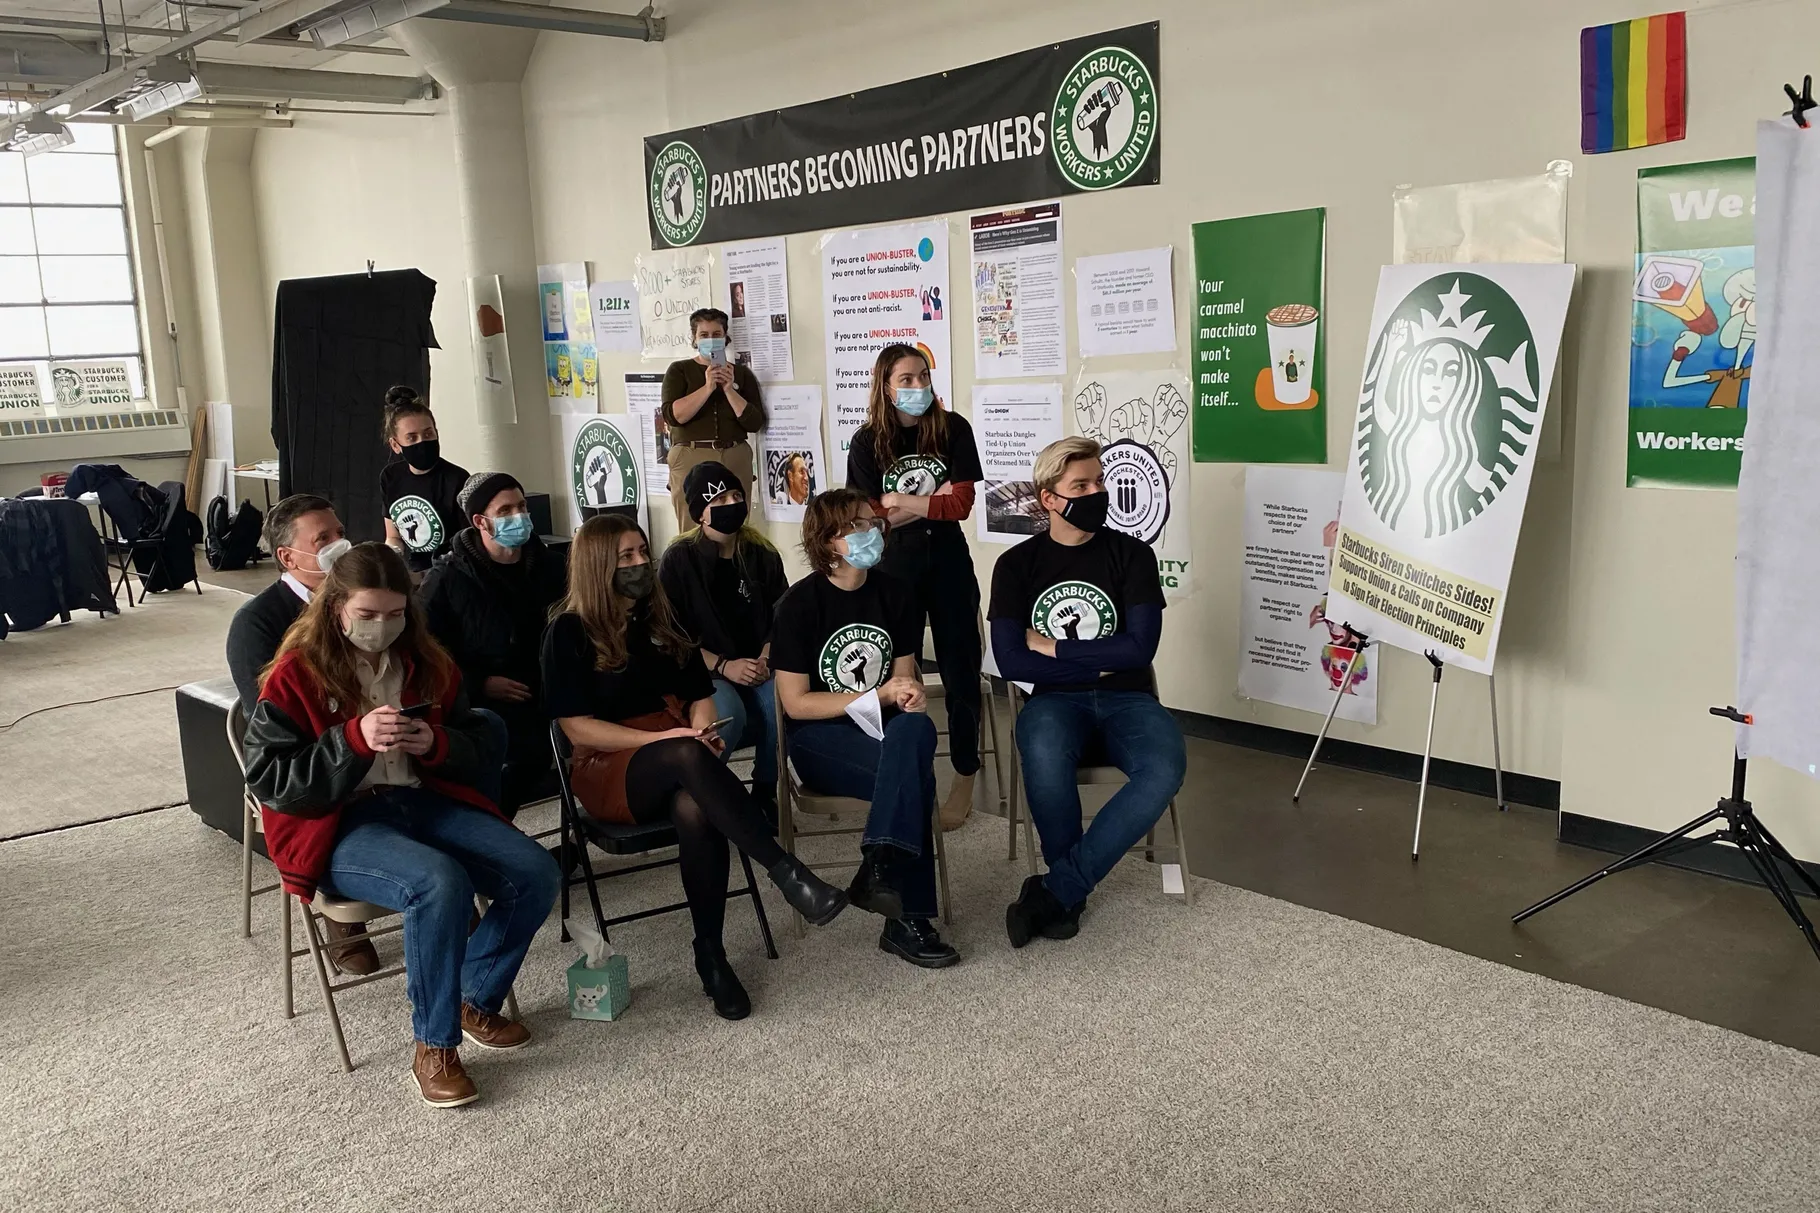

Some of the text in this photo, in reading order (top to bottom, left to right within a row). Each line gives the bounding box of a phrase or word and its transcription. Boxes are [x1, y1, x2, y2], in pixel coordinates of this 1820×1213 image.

[1066, 56, 1143, 99] STARBUCKS
[1056, 110, 1150, 181] WORKERS UNITED
[657, 148, 700, 178] STARBUCKS
[710, 111, 1046, 208] PARTNERS BECOMING PARTNERS
[1669, 188, 1743, 222] We
[653, 189, 702, 239] WORKERS UNITED
[831, 257, 835, 265] If
[836, 257, 847, 266] you
[866, 248, 916, 261] UNION-BUSTER,
[672, 265, 706, 278] STARBUCKS
[832, 271, 842, 280] you
[867, 266, 876, 274] for
[878, 262, 922, 274] sustainability.
[681, 277, 701, 288] STORES
[1200, 279, 1224, 293] Your
[833, 294, 837, 302] If
[838, 295, 849, 304] you
[867, 288, 917, 300] UNION-BUSTER,
[599, 298, 630, 313] 1,211 x
[665, 297, 699, 314] UNIONS
[833, 308, 844, 317] you
[869, 304, 902, 313] anti-racist.
[1200, 298, 1244, 316] caramel
[834, 331, 838, 339] If
[840, 333, 851, 341] you
[869, 328, 919, 338] UNION-BUSTER,
[1200, 322, 1257, 339] macchiato
[835, 345, 846, 353] you
[859, 343, 869, 351] not
[86, 375, 126, 383] CUSTOMER
[836, 368, 840, 376] If
[841, 370, 852, 378] you
[1201, 369, 1229, 384] make
[836, 382, 847, 390] you
[90, 395, 131, 404] UNION
[1201, 391, 1239, 407] itself...
[843, 406, 853, 415] you
[838, 418, 848, 426] you
[1014, 431, 1036, 439] Dangles
[1636, 431, 1745, 451] Workers
[1109, 467, 1144, 482] ROCHESTER
[1133, 453, 1159, 487] UNITED
[395, 500, 436, 522] STARBUCKS
[1138, 503, 1147, 518] BOARD
[1281, 505, 1308, 513] Starbucks
[1255, 545, 1269, 553] firmly
[1245, 560, 1275, 569] outstanding
[1277, 564, 1313, 573] compensation
[1246, 553, 1279, 562] environment,
[1281, 557, 1302, 565] coupled
[1255, 568, 1277, 576] benefits,
[1341, 533, 1495, 614] Starbucks Siren Switches Sides!
[1250, 575, 1282, 585] unnecessary
[1290, 580, 1318, 590] Starbucks.
[1043, 586, 1107, 611] STARBUCKS
[1339, 554, 1485, 635] Supports Union & Calls on Company
[1271, 599, 1290, 607] respect
[1342, 579, 1466, 650] to Sign Fair Election Principles
[830, 629, 888, 654] STARBUCKS
[1264, 638, 1282, 646] believe
[1295, 643, 1306, 651] they
[1248, 650, 1275, 659] necessary
[1251, 658, 1271, 666] partner
